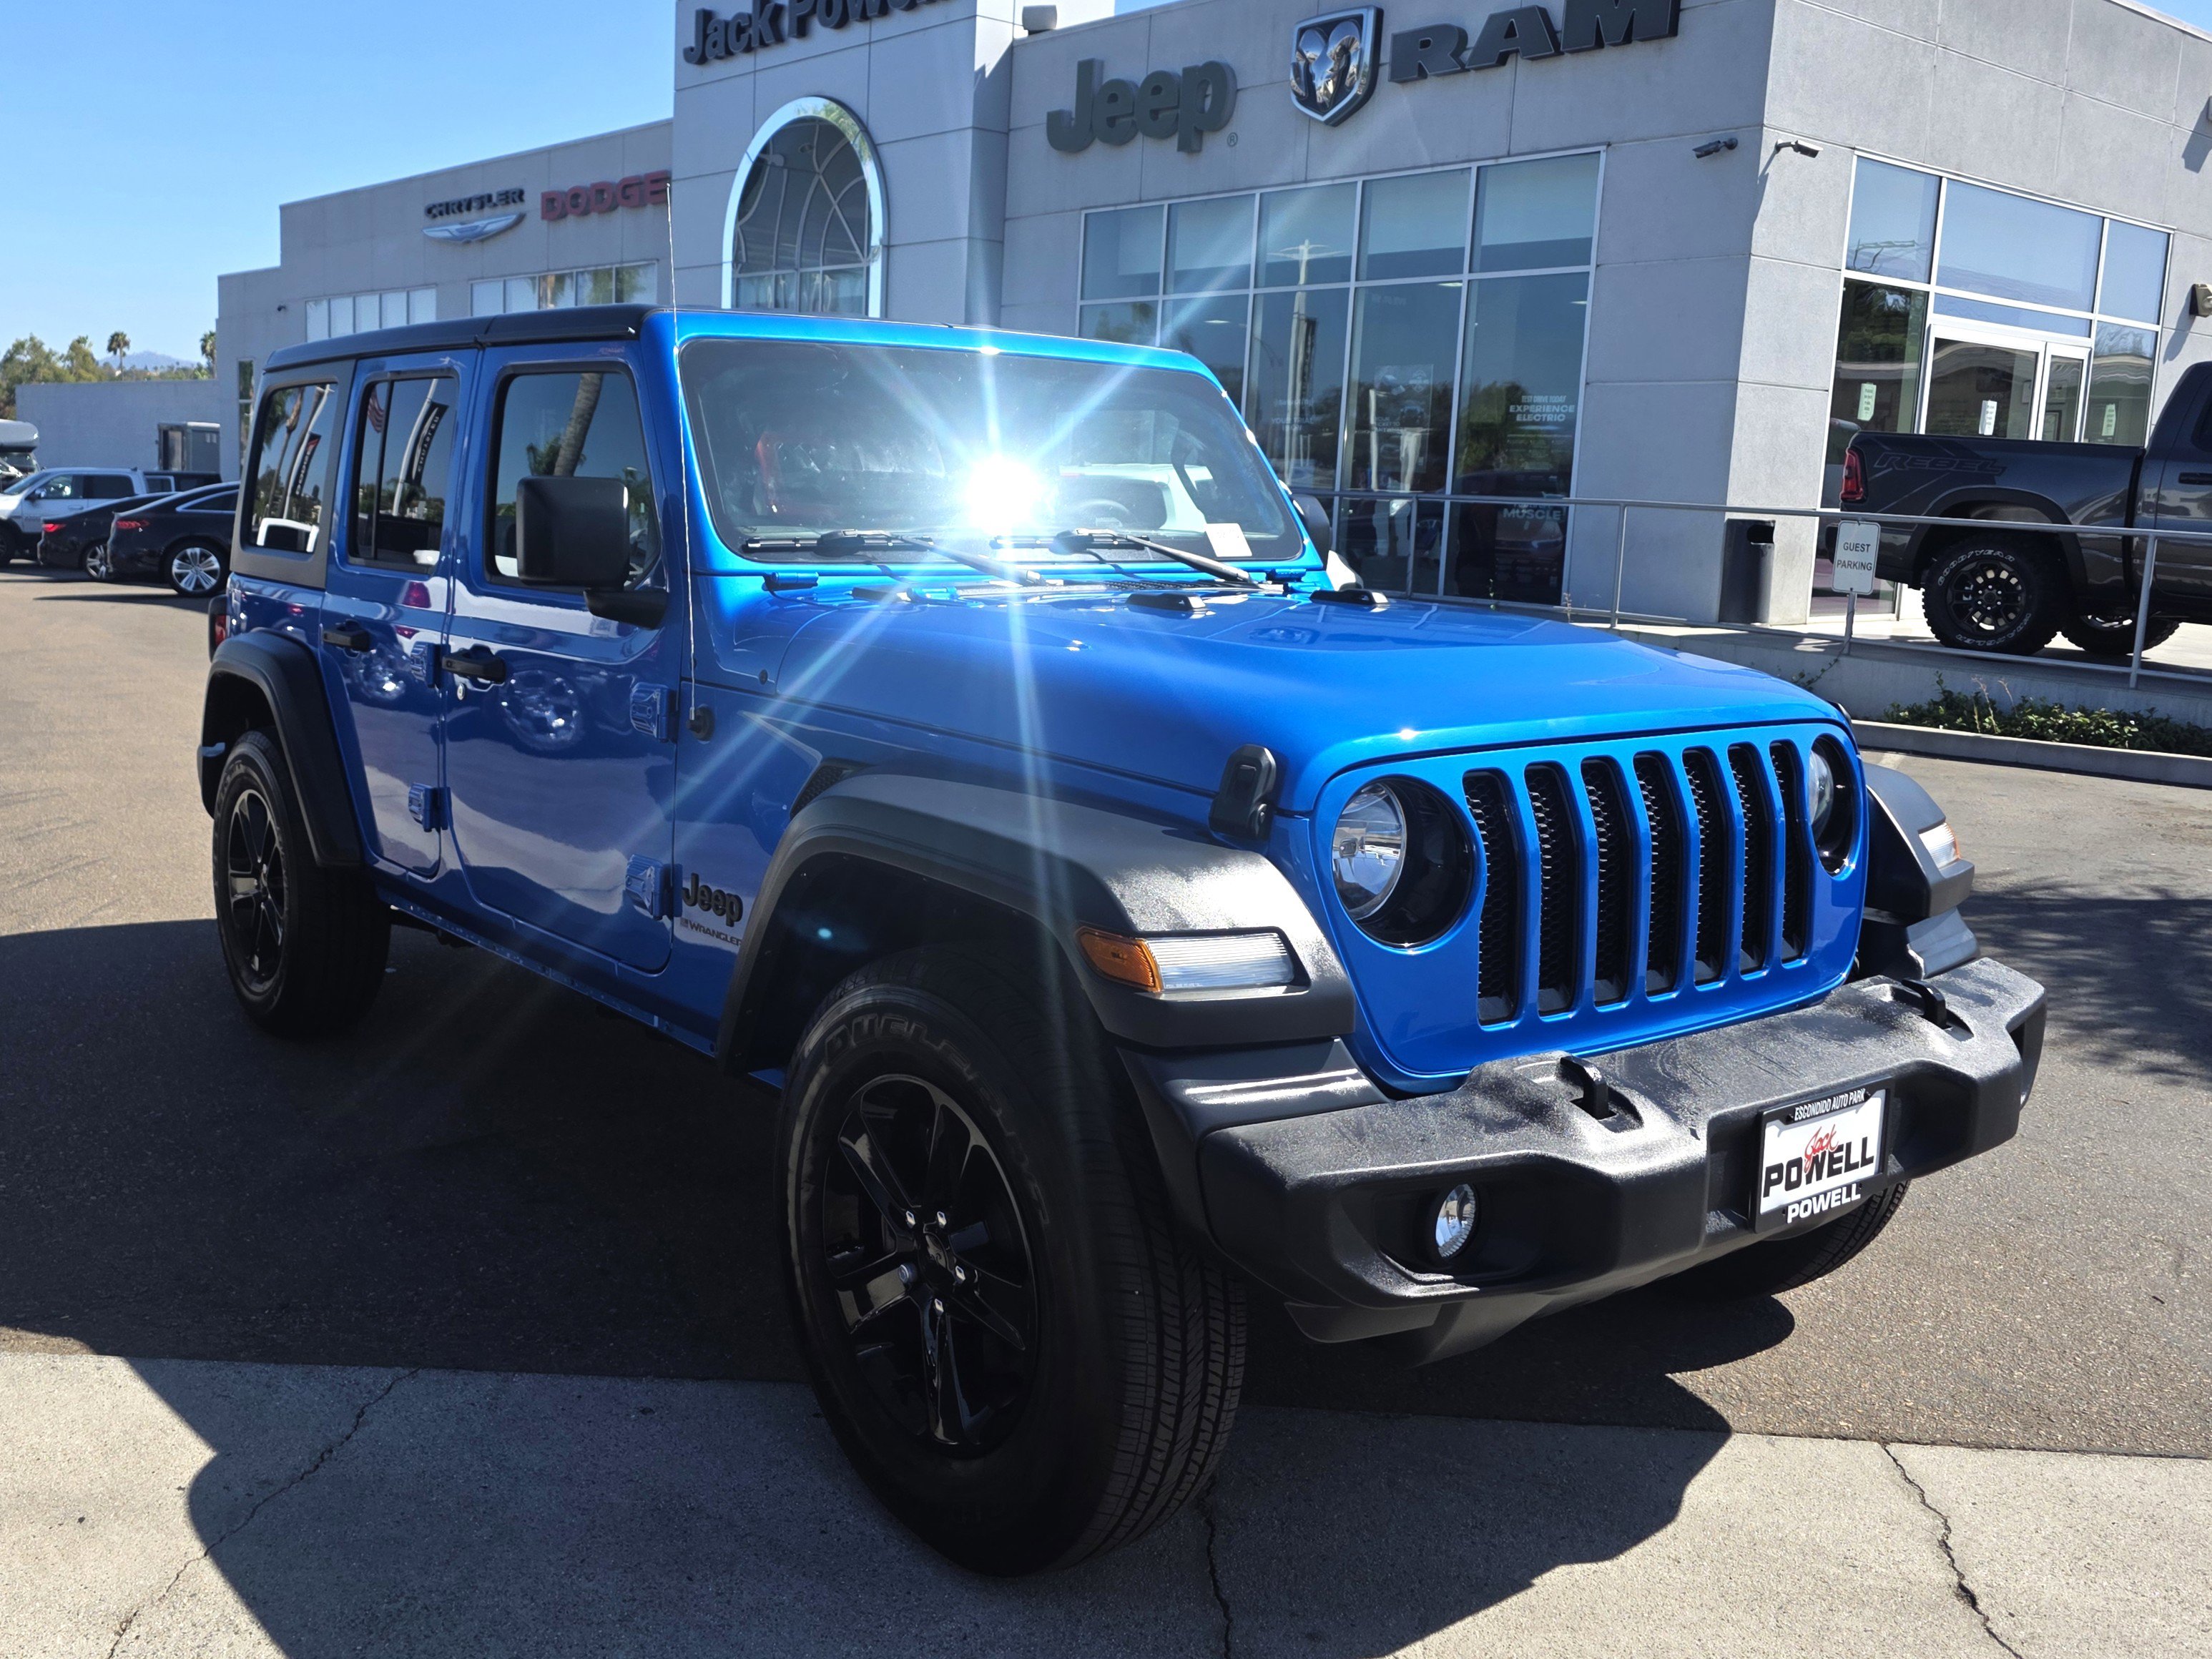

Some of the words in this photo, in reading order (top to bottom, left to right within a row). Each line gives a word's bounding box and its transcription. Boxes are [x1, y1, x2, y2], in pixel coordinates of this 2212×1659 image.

[682, 0, 785, 65] Jack
[1388, 0, 1678, 84] RAM
[1046, 57, 1238, 153] Jeep
[424, 187, 525, 219] CHRYSLER
[540, 169, 672, 222] DODGE
[1515, 413, 1566, 422] ELECTRIC
[1873, 451, 2006, 475] REBEL
[1503, 508, 1561, 521] MUSCLE
[1836, 559, 1872, 571] PARKING
[1843, 541, 1871, 553] GUEST
[1937, 548, 2016, 586] GOODYEAR
[682, 872, 743, 927] Jeep
[1794, 1098, 1832, 1121] ESCONDIDO
[1831, 1093, 1848, 1111] AUTO
[1848, 1088, 1867, 1106] PARK
[1762, 1136, 1875, 1198] POWELL
[1804, 1123, 1839, 1174] Jack
[1786, 1183, 1861, 1224] POWELL
